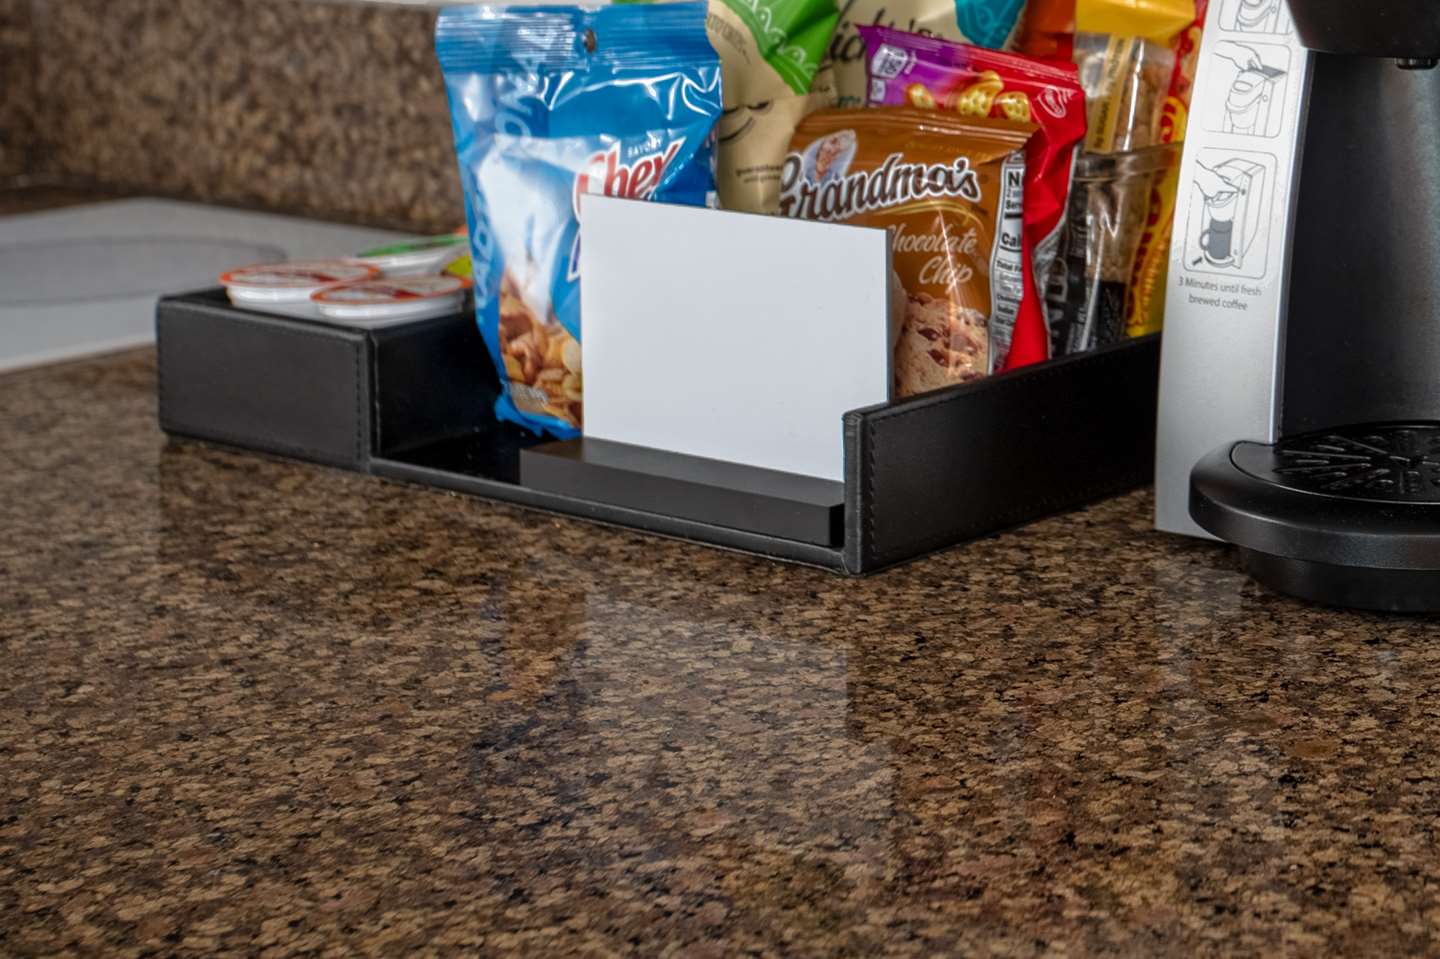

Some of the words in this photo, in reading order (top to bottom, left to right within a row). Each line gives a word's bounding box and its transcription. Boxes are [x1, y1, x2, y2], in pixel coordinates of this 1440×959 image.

[573, 136, 688, 218] Chex
[780, 152, 982, 221] Grandma's
[919, 256, 973, 295] Chip
[1185, 277, 1218, 292] Minutes
[1220, 283, 1239, 294] until
[1241, 285, 1262, 297] fresh
[1188, 294, 1220, 307] brewed
[1222, 298, 1248, 311] coffee
